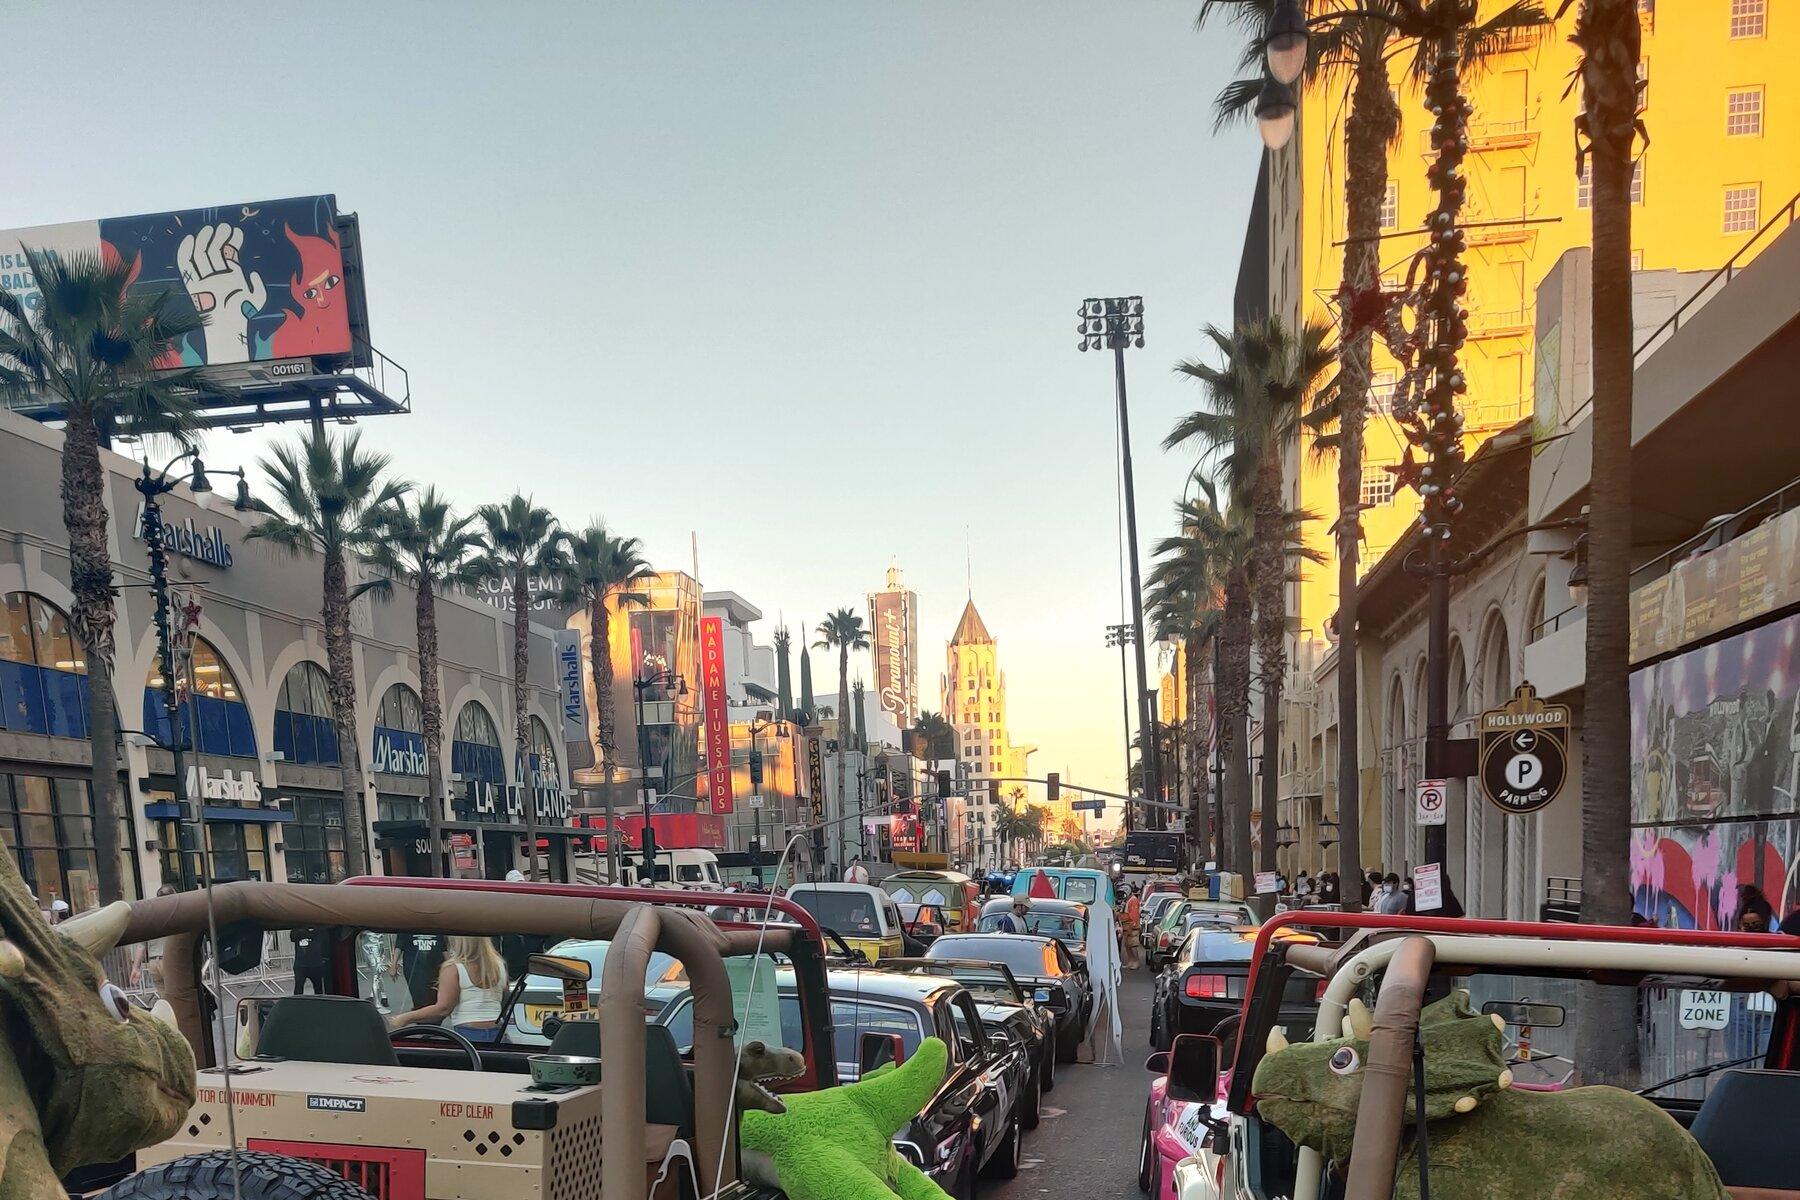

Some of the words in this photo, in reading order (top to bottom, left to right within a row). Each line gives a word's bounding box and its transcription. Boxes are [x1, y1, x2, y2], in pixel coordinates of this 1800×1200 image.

[273, 364, 305, 375] 001161
[476, 576, 564, 594] ACAEMY
[561, 644, 582, 725] Marshalls
[706, 622, 720, 700] MADAME
[713, 708, 726, 809] TUSSAUDS
[1488, 712, 1562, 727] HOLLYWOOD
[1519, 760, 1533, 783] P
[475, 780, 496, 813] LA
[506, 784, 524, 816] LA
[534, 788, 567, 818] LAND
[1690, 991, 1722, 1004] TAXI
[1684, 1008, 1725, 1021] ZONE
[319, 1098, 363, 1109] IMPACT
[440, 1102, 462, 1117] KEEP
[466, 1105, 493, 1119] CLEAR
[1177, 1122, 1199, 1149] FURIOUS
